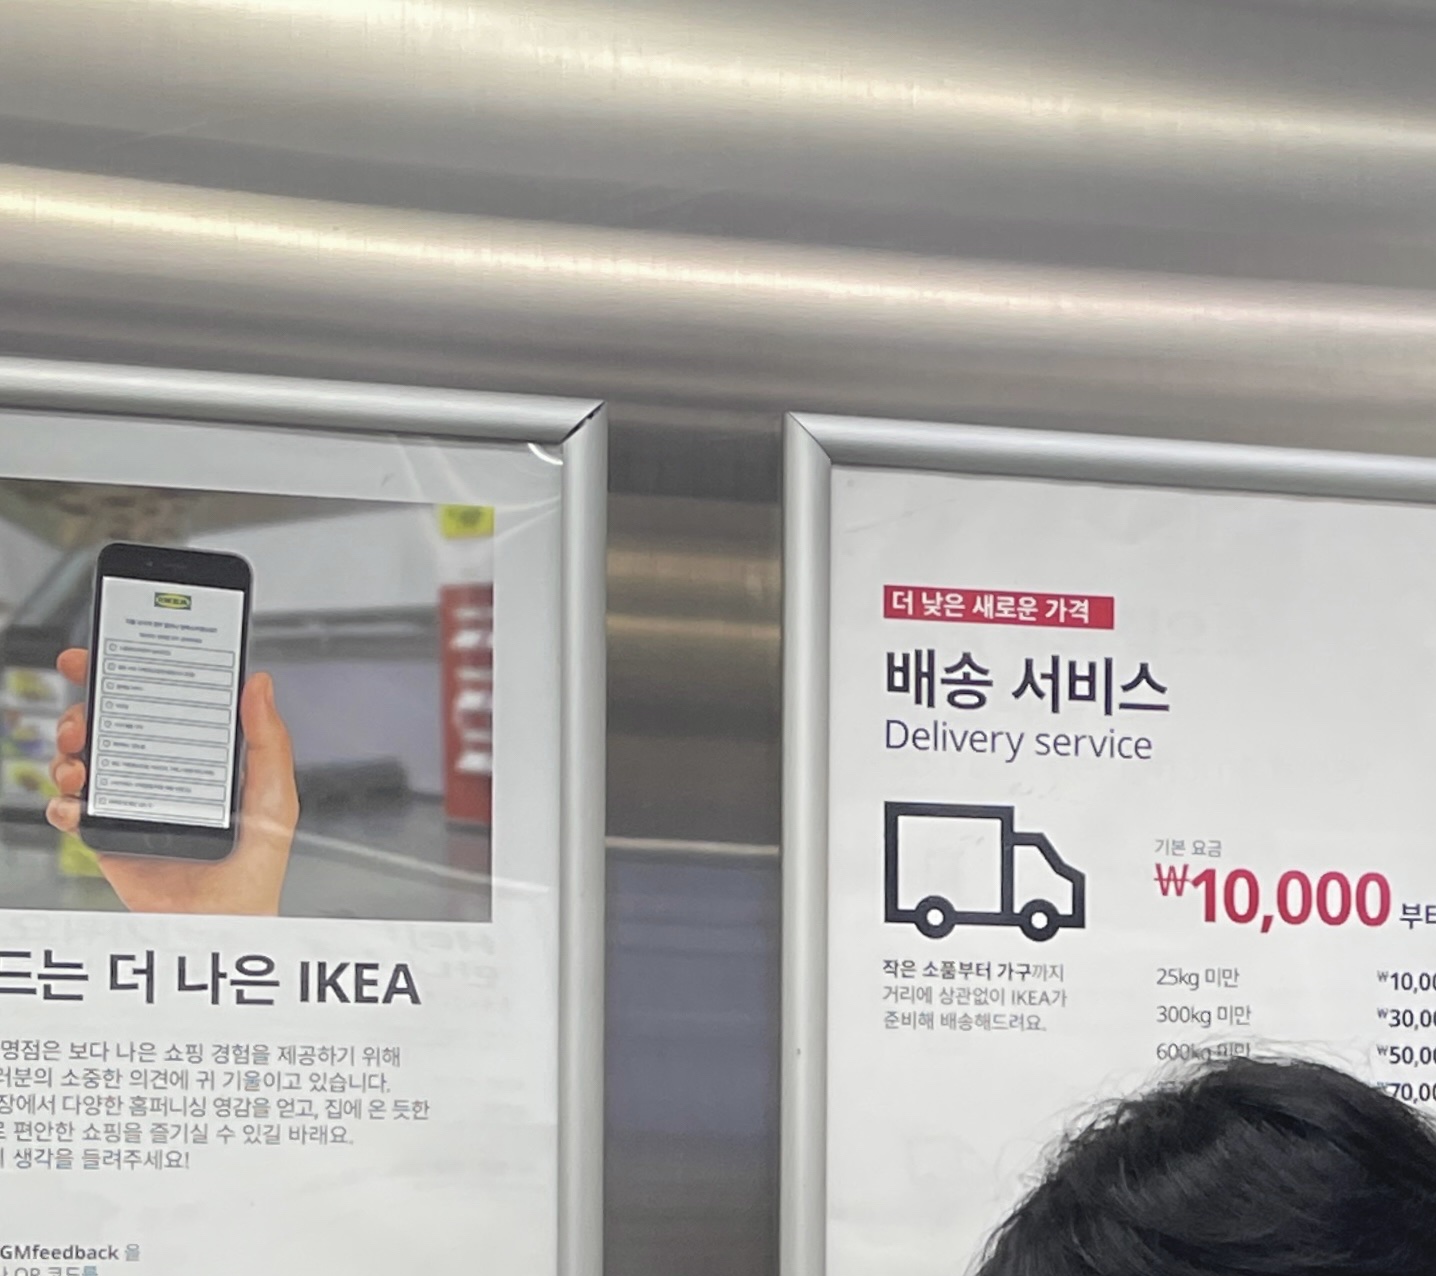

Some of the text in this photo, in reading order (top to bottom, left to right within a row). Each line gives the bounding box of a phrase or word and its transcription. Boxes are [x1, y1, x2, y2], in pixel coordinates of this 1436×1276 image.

[892, 590, 1090, 624] 더 낮은 새로운 가격
[886, 648, 1170, 716] 배송 서비스
[885, 719, 1153, 763] Delivery service
[1154, 838, 1223, 858] 기본 요금
[109, 949, 154, 1004] 더
[177, 952, 280, 1006] 나은
[300, 960, 422, 1005] IKEA
[882, 958, 1064, 983] 작은 소품부터 가구까지
[1156, 966, 1240, 991] 25kg 미만
[882, 984, 1068, 1008] 거리에 상관없이 IKEA가
[883, 1010, 935, 1030] 준비해
[1156, 1003, 1252, 1029] 300kg 미만
[68, 1041, 110, 1063] 보다
[116, 1041, 158, 1064] 나은
[164, 1042, 204, 1065] 쇼핑
[211, 1043, 271, 1066] 경험을
[277, 1044, 356, 1067] 제공하기
[362, 1046, 401, 1068] 위해
[60, 1067, 123, 1089] 소중한
[129, 1068, 189, 1091] 의견에
[196, 1070, 215, 1086] 귀
[222, 1070, 302, 1092] 기울이고
[309, 1072, 391, 1094] 있습니다.
[62, 1095, 123, 1117] 다양한
[129, 1095, 207, 1118] 홈퍼니싱
[213, 1097, 271, 1119] 영감을
[325, 1098, 363, 1120] 집에
[368, 1099, 387, 1120] 온
[392, 1099, 430, 1121] 듯한
[14, 1120, 75, 1143] 편안한
[82, 1121, 143, 1144] 쇼핑을
[149, 1122, 209, 1145] 즐기실
[216, 1124, 236, 1145] 수
[243, 1124, 281, 1146] 있길
[14, 1147, 74, 1170] 생각을
[82, 1149, 190, 1171] 들려주세요!
